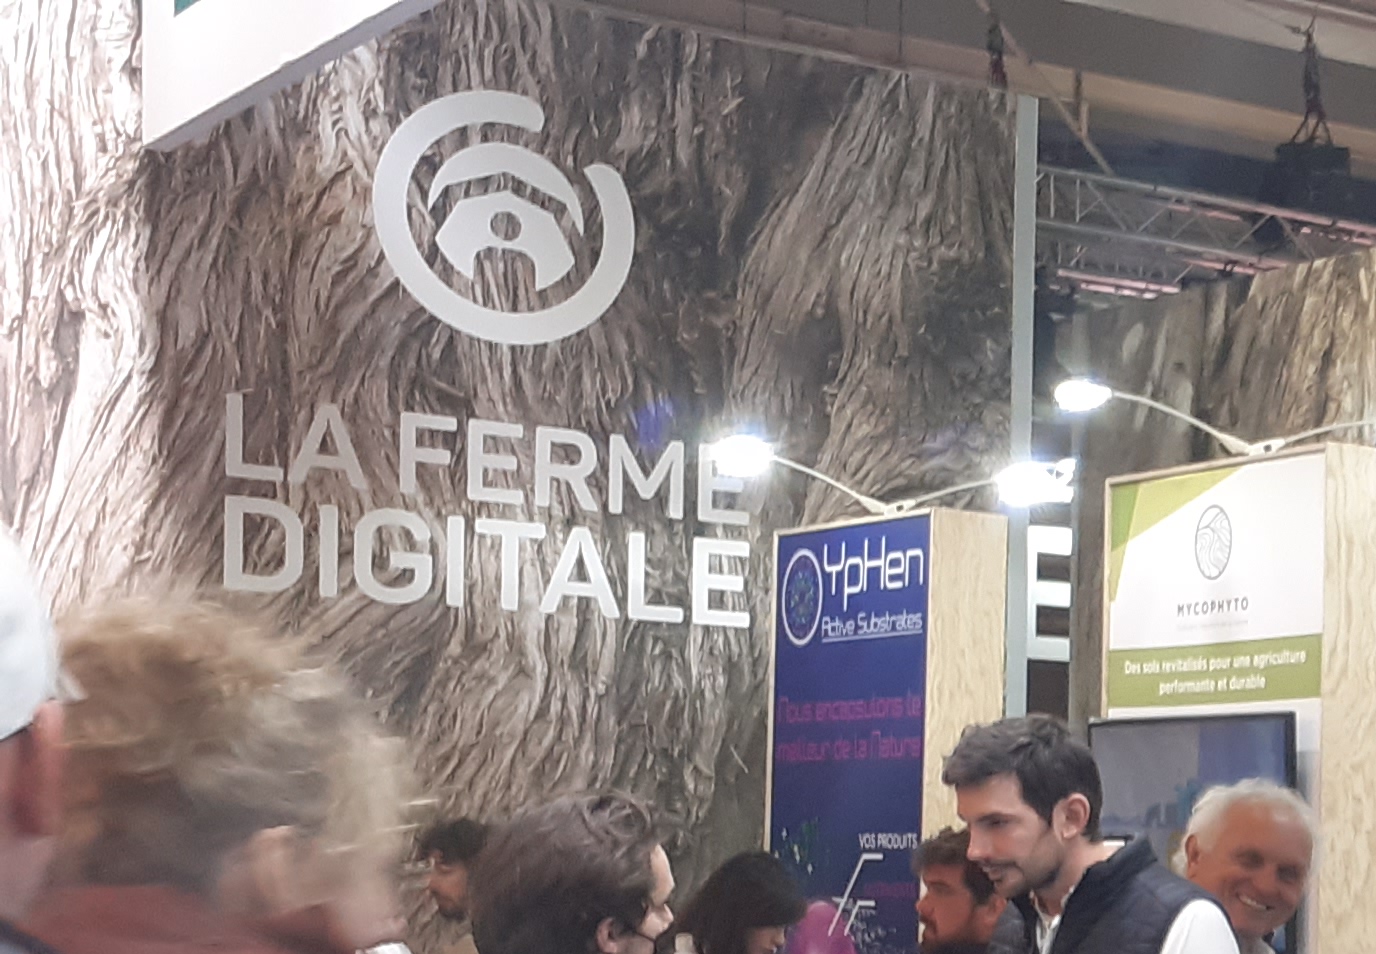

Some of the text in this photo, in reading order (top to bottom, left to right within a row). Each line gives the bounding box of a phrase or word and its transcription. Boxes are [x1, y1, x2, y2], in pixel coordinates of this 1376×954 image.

[225, 392, 751, 525] LA FERME
[223, 494, 751, 628] DIGITALE
[823, 536, 924, 612] YpHen
[1177, 597, 1249, 617] MYCOPHYTO
[822, 608, 923, 637] Active Substrates
[1125, 660, 1141, 674] Des
[1162, 655, 1207, 673] revitalisés
[1209, 655, 1231, 672] pour
[1233, 656, 1251, 669] une
[1253, 649, 1307, 669] agriculture
[1159, 674, 1266, 696] performante et durable
[857, 832, 918, 850] VOS PRODUITS
